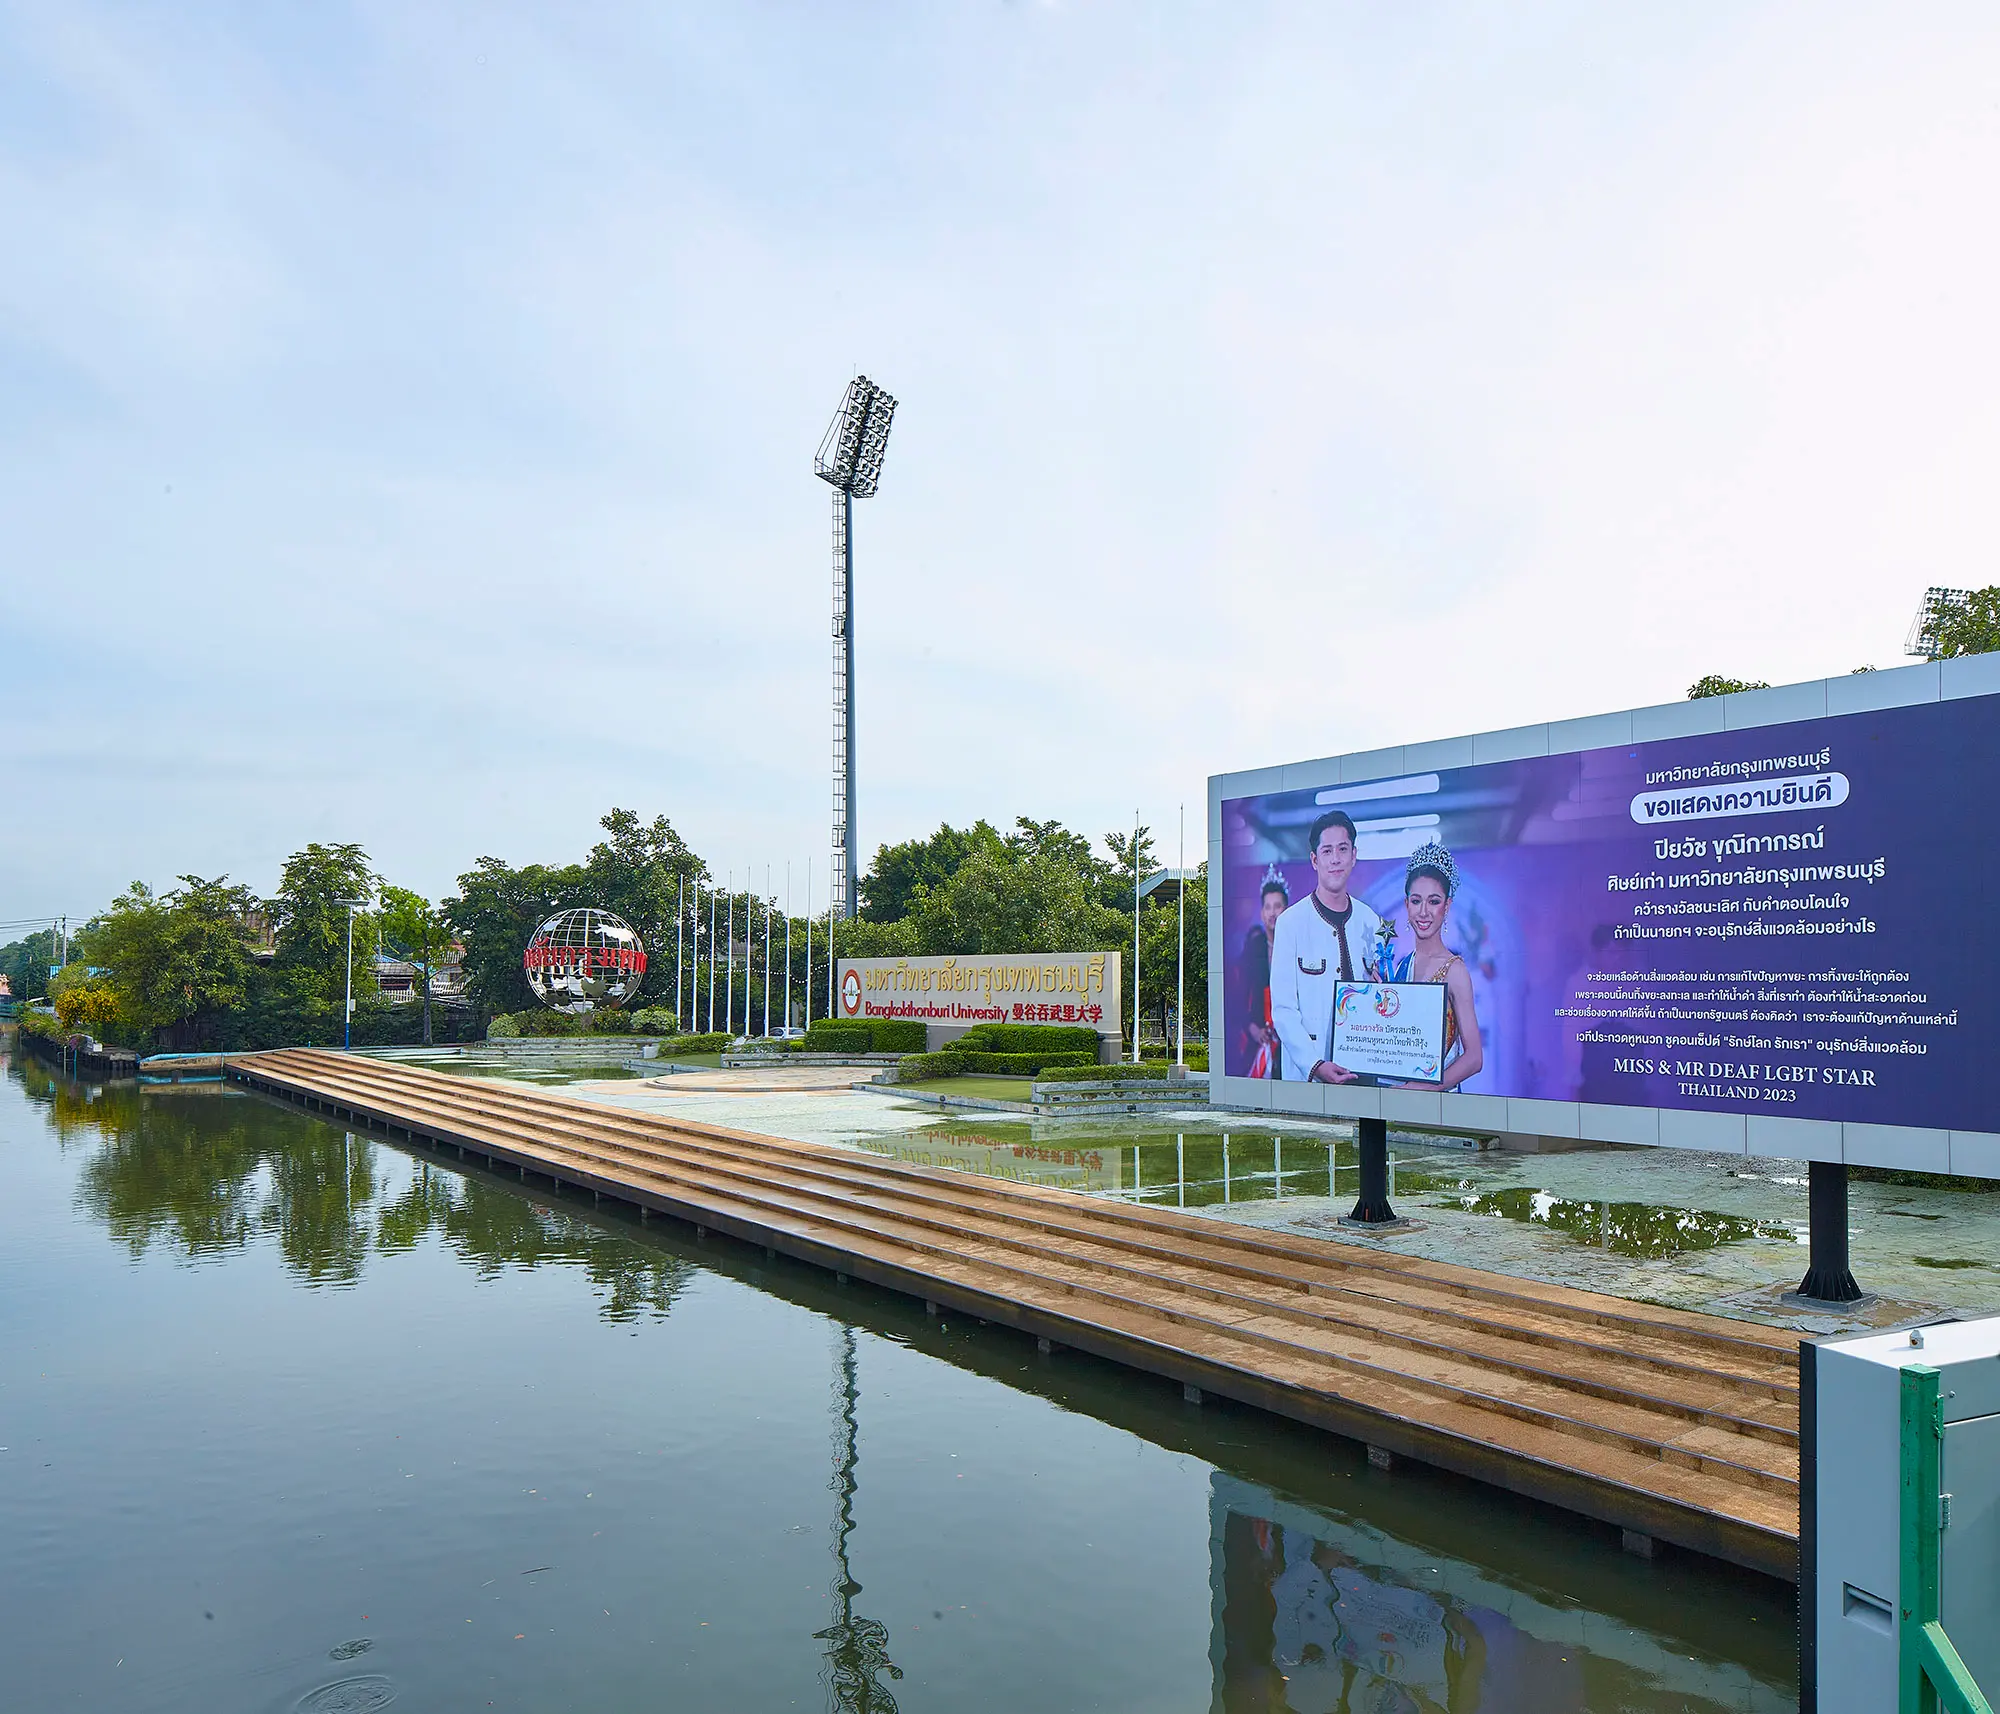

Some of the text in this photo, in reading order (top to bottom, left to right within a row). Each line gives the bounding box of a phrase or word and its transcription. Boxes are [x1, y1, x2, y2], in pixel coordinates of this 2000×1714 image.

[1645, 747, 1831, 785] มหาวิทยาลัยกรุงเทพธนบุรี
[1644, 776, 1832, 817] ขอแสดงความยินดี
[1654, 824, 1825, 863] ปิยวัช ขุณิกากรณ์
[1607, 857, 1887, 891] ศิษย์เก่า มหาวิทยาลัยกรุงเทพธนบุรี
[1634, 893, 1850, 916] คว้ารางวัลชนะเลิศ กับคำตอบโดนใจ
[1613, 917, 1876, 941] ถ้าเป็นนายกฯ จะอนุรักษ์สิ่งแวดล้อมอย่างไร
[865, 954, 1105, 1006] มหาวิทยาลัยกรุงเทพธนบุรี
[1587, 968, 1909, 985] จะช่วยเหลือด้านสิ่งแวดล้อม เช่น การแก้ไขปัญหาขยะ การทิ้งขยะให้ถูกต้อง
[1808, 988, 1927, 1003] ต้องทำให้น้ำสะอาดก่อน
[865, 1000, 1009, 1024] Bangkokthonburi University
[1012, 1003, 1103, 1024] 曼谷吞武里大学
[1658, 1007, 1749, 1022] ถ้าเป็นนายกรัฐมนตรี
[1751, 1009, 1797, 1022] ต้องคิดว่า
[1803, 1010, 1959, 1026] เราจะต้องแก้ปัญหาด้านเหล่านี้
[1576, 1031, 1663, 1048] เวทีประกวดหูหนวก
[1665, 1032, 1721, 1049] ชูคอนเซ็ปต์
[1774, 1036, 1813, 1050] รักเรา"
[1816, 1036, 1927, 1055] อนุรักษ์สิ่งแวดล้อม
[1613, 1058, 1877, 1087] MISS & MR DEAF LGBT STAR
[1677, 1082, 1797, 1102] THAILAND 2023
